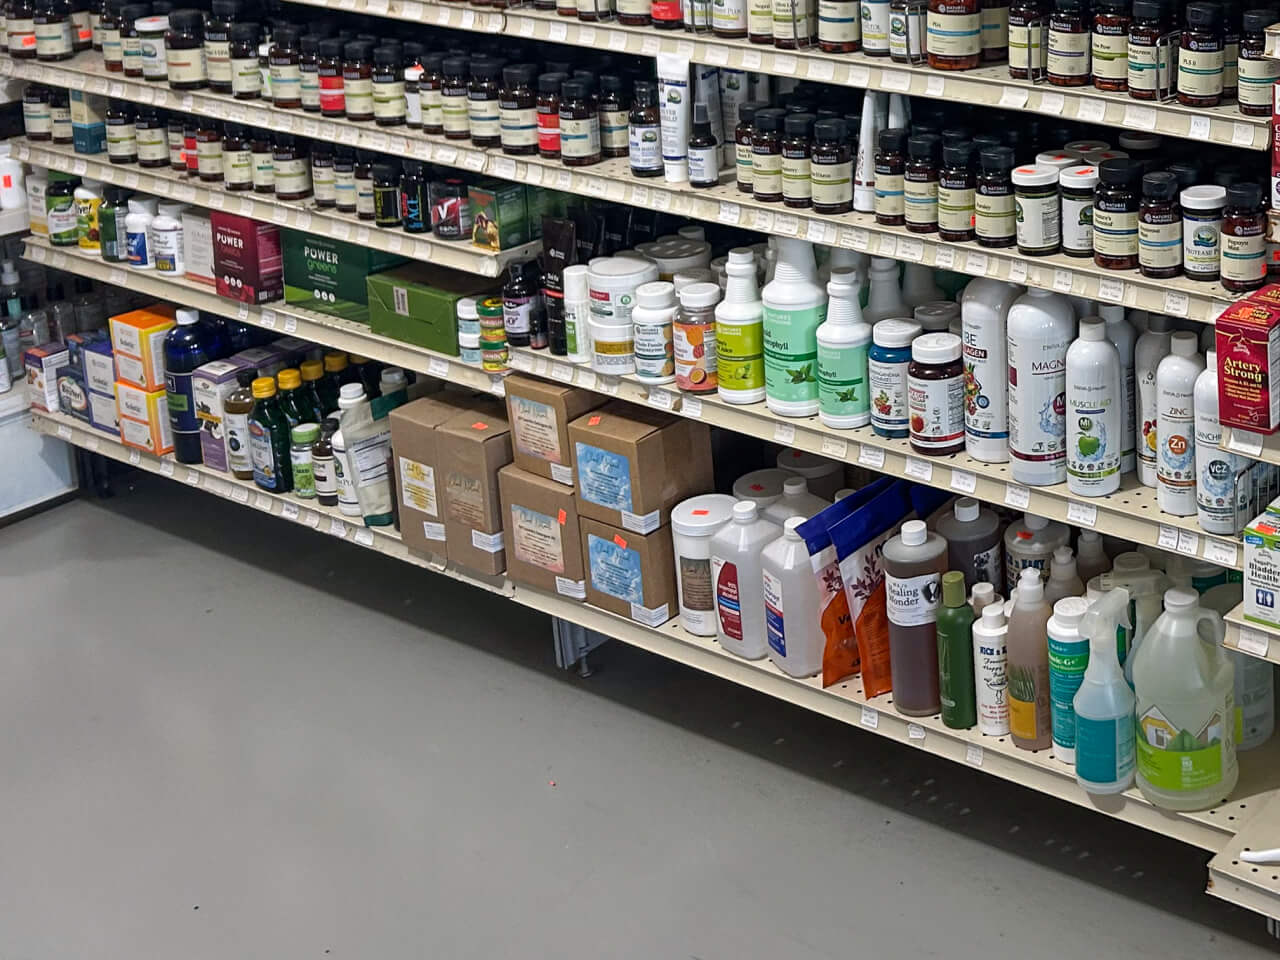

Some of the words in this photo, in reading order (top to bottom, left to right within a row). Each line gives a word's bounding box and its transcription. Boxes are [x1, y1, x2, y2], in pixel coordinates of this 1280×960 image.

[217, 233, 243, 248] POWER
[304, 247, 338, 264] POWER
[1224, 357, 1260, 373] Artery
[1224, 364, 1262, 381] Strong
[1170, 438, 1184, 449] Zn
[1211, 464, 1226, 473] VCZ
[1249, 562, 1280, 578] Bladder
[1251, 571, 1279, 584] Health
